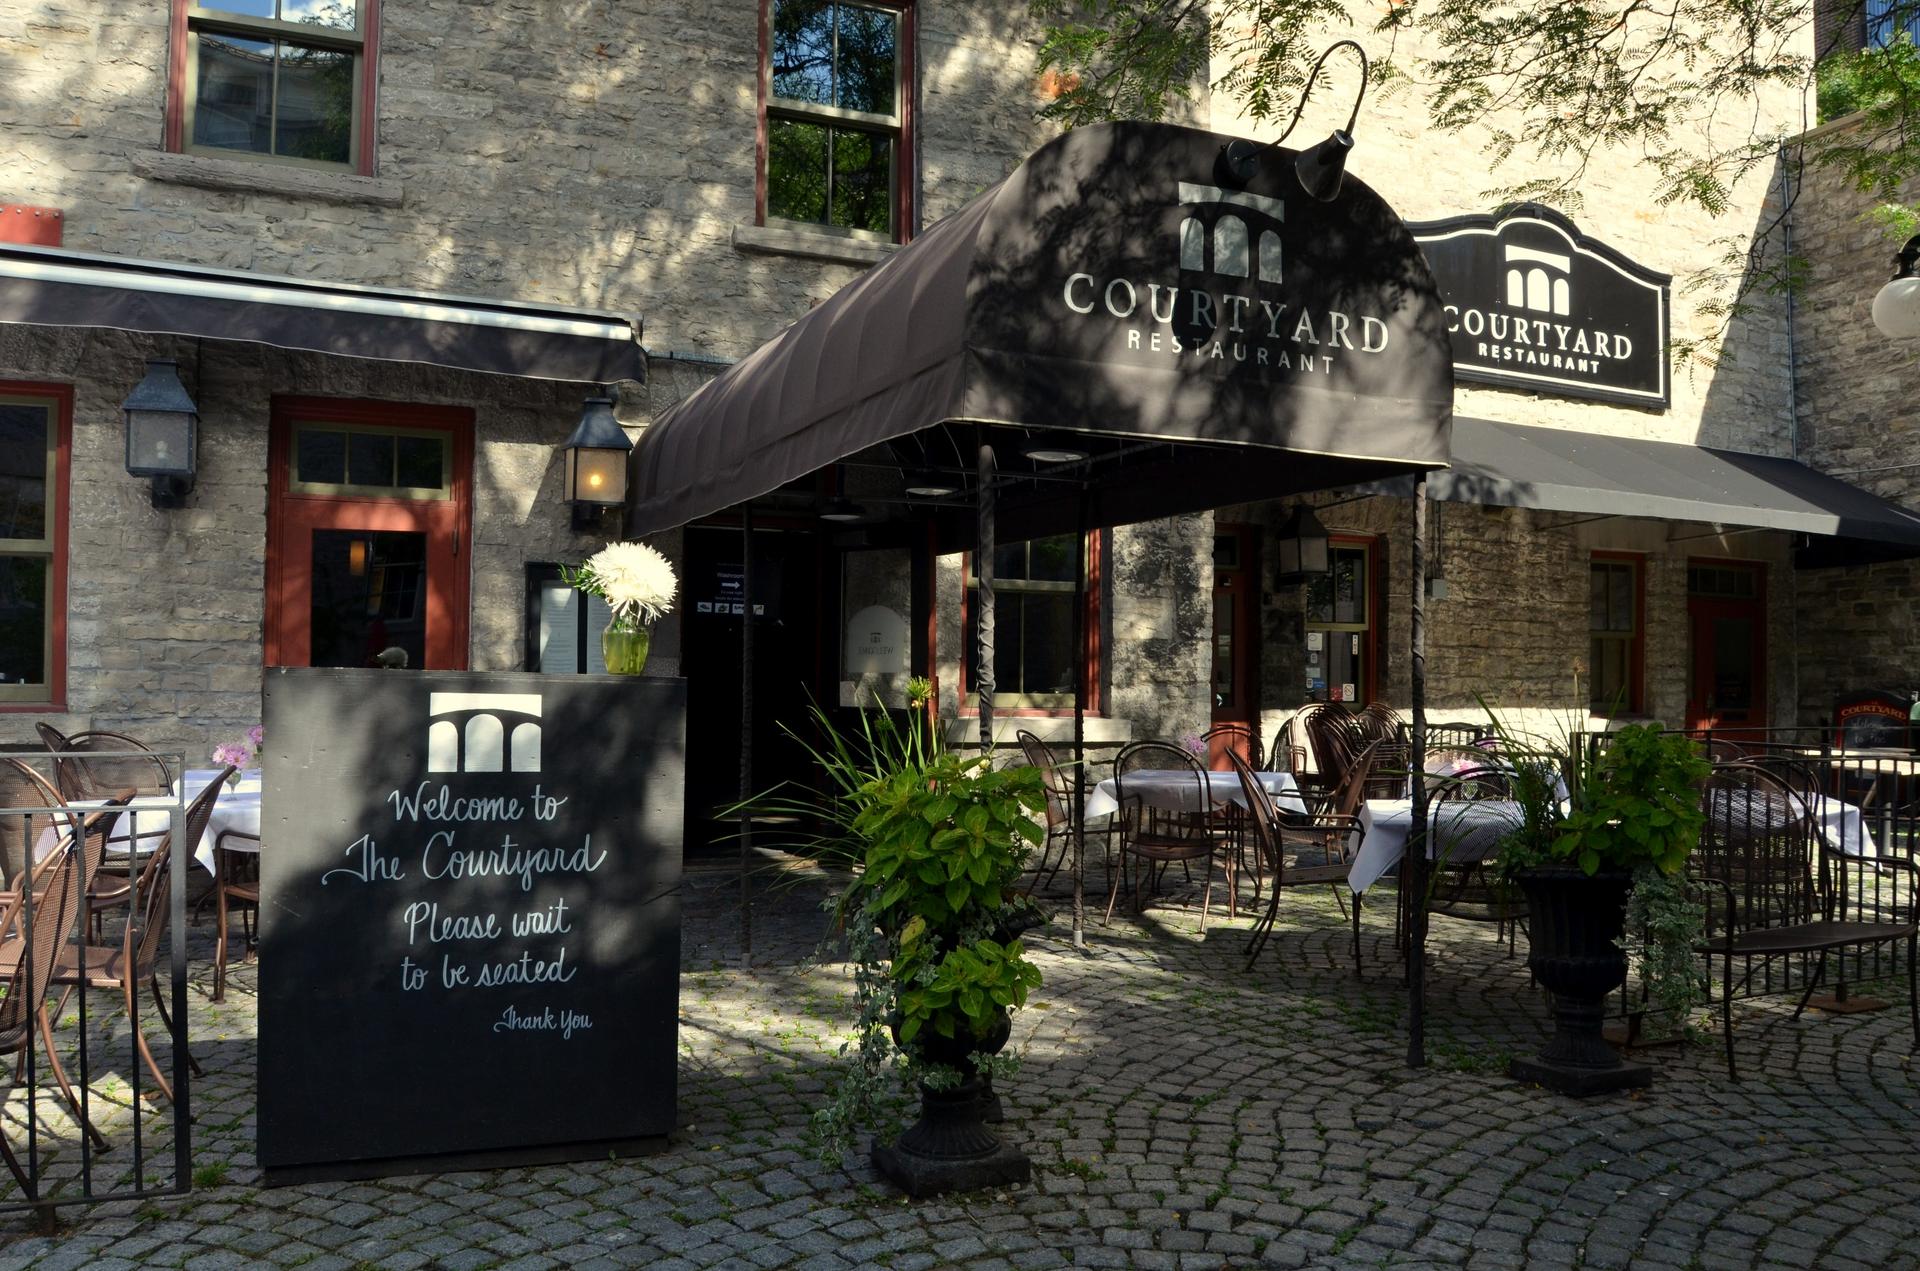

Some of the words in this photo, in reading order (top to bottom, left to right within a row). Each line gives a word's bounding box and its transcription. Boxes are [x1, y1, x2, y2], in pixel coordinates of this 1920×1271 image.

[1063, 272, 1389, 353] COURTYARD
[1443, 305, 1633, 360] COURTYARD
[1128, 329, 1335, 375] RESTAURANT
[1478, 342, 1600, 374] RESTAURANT
[1840, 704, 1907, 720] COURTYARD
[388, 781, 524, 822] Welcome
[531, 784, 568, 821] to
[322, 834, 405, 886] The
[422, 831, 608, 892] Courtyard
[404, 901, 501, 945] Please
[513, 898, 571, 937] wait
[401, 957, 428, 991] to
[443, 954, 469, 988] be
[474, 947, 577, 987] seated
[493, 1005, 557, 1033] Thank
[561, 1009, 593, 1040] You
